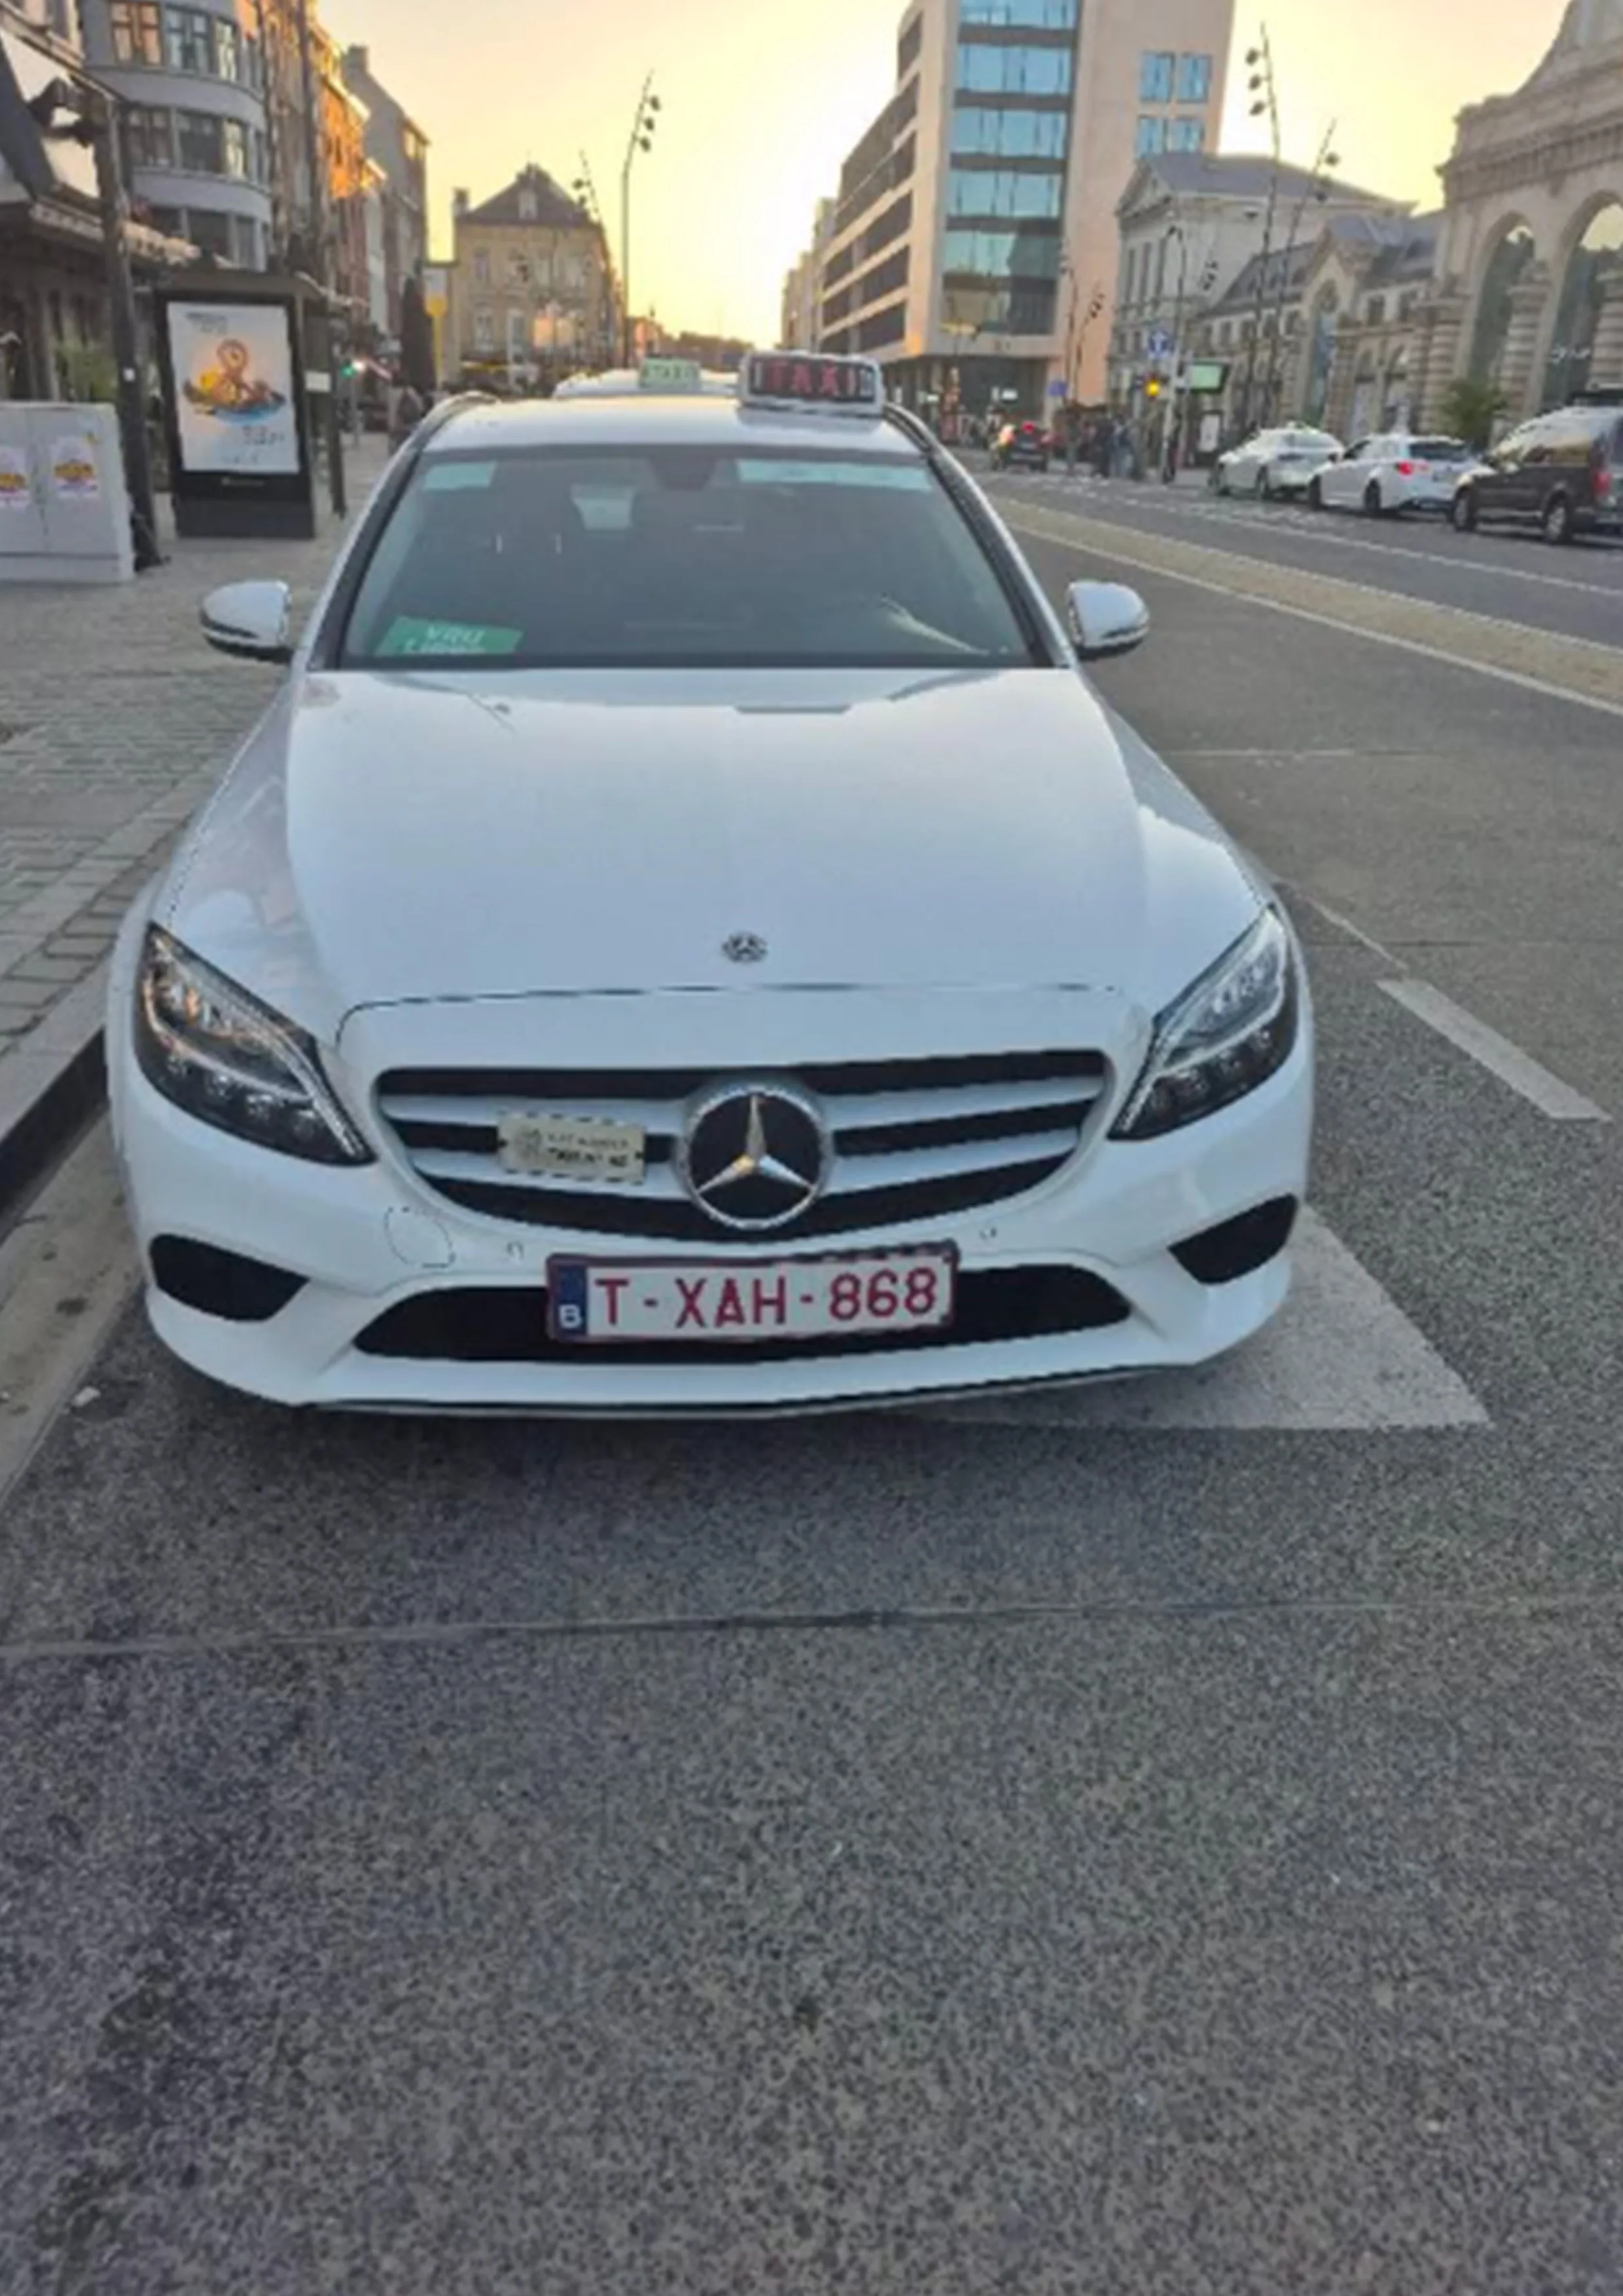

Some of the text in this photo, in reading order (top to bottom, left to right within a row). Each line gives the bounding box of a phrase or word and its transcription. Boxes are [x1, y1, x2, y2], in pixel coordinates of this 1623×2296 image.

[768, 360, 855, 396] TAXI
[594, 1266, 938, 1329] T-XAH-868
[560, 1304, 582, 1329] B
